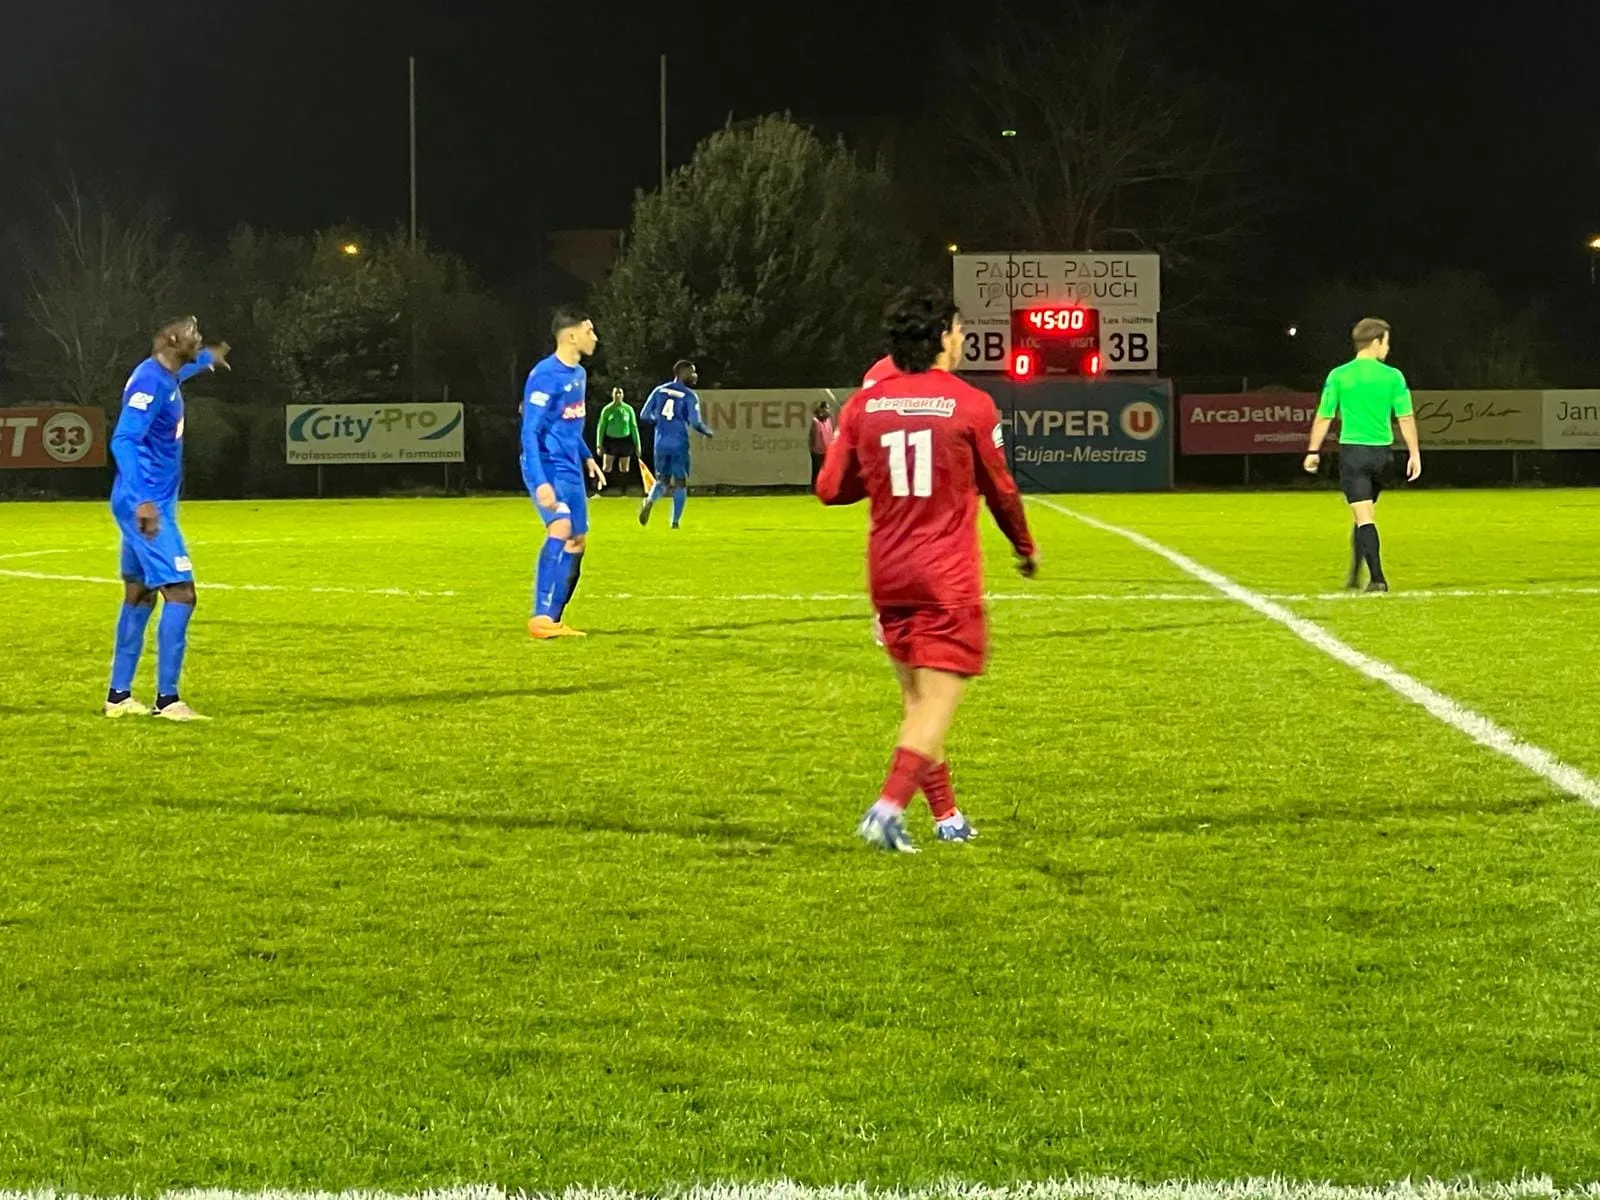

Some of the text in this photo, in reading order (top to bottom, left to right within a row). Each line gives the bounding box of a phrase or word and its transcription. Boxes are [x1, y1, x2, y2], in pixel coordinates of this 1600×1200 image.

[976, 261, 1048, 278] PADEL
[1064, 261, 1136, 278] PADEL
[977, 282, 1048, 301] TOUCH
[1065, 282, 1137, 301] TOUCH
[1029, 310, 1084, 330] 45:00
[965, 332, 1005, 362] 3B
[1108, 332, 1149, 362] 3B
[1015, 354, 1029, 375] 0
[1091, 355, 1099, 374] 1
[661, 399, 675, 421] 4
[1190, 406, 1315, 424] ArcaJetMar
[1556, 401, 1600, 421] Jan
[311, 408, 437, 443] City Pro
[1000, 410, 1153, 436] HYPER U
[49, 426, 86, 446] 33
[881, 430, 932, 497] 11
[1014, 446, 1147, 465] Gujan-Mestras
